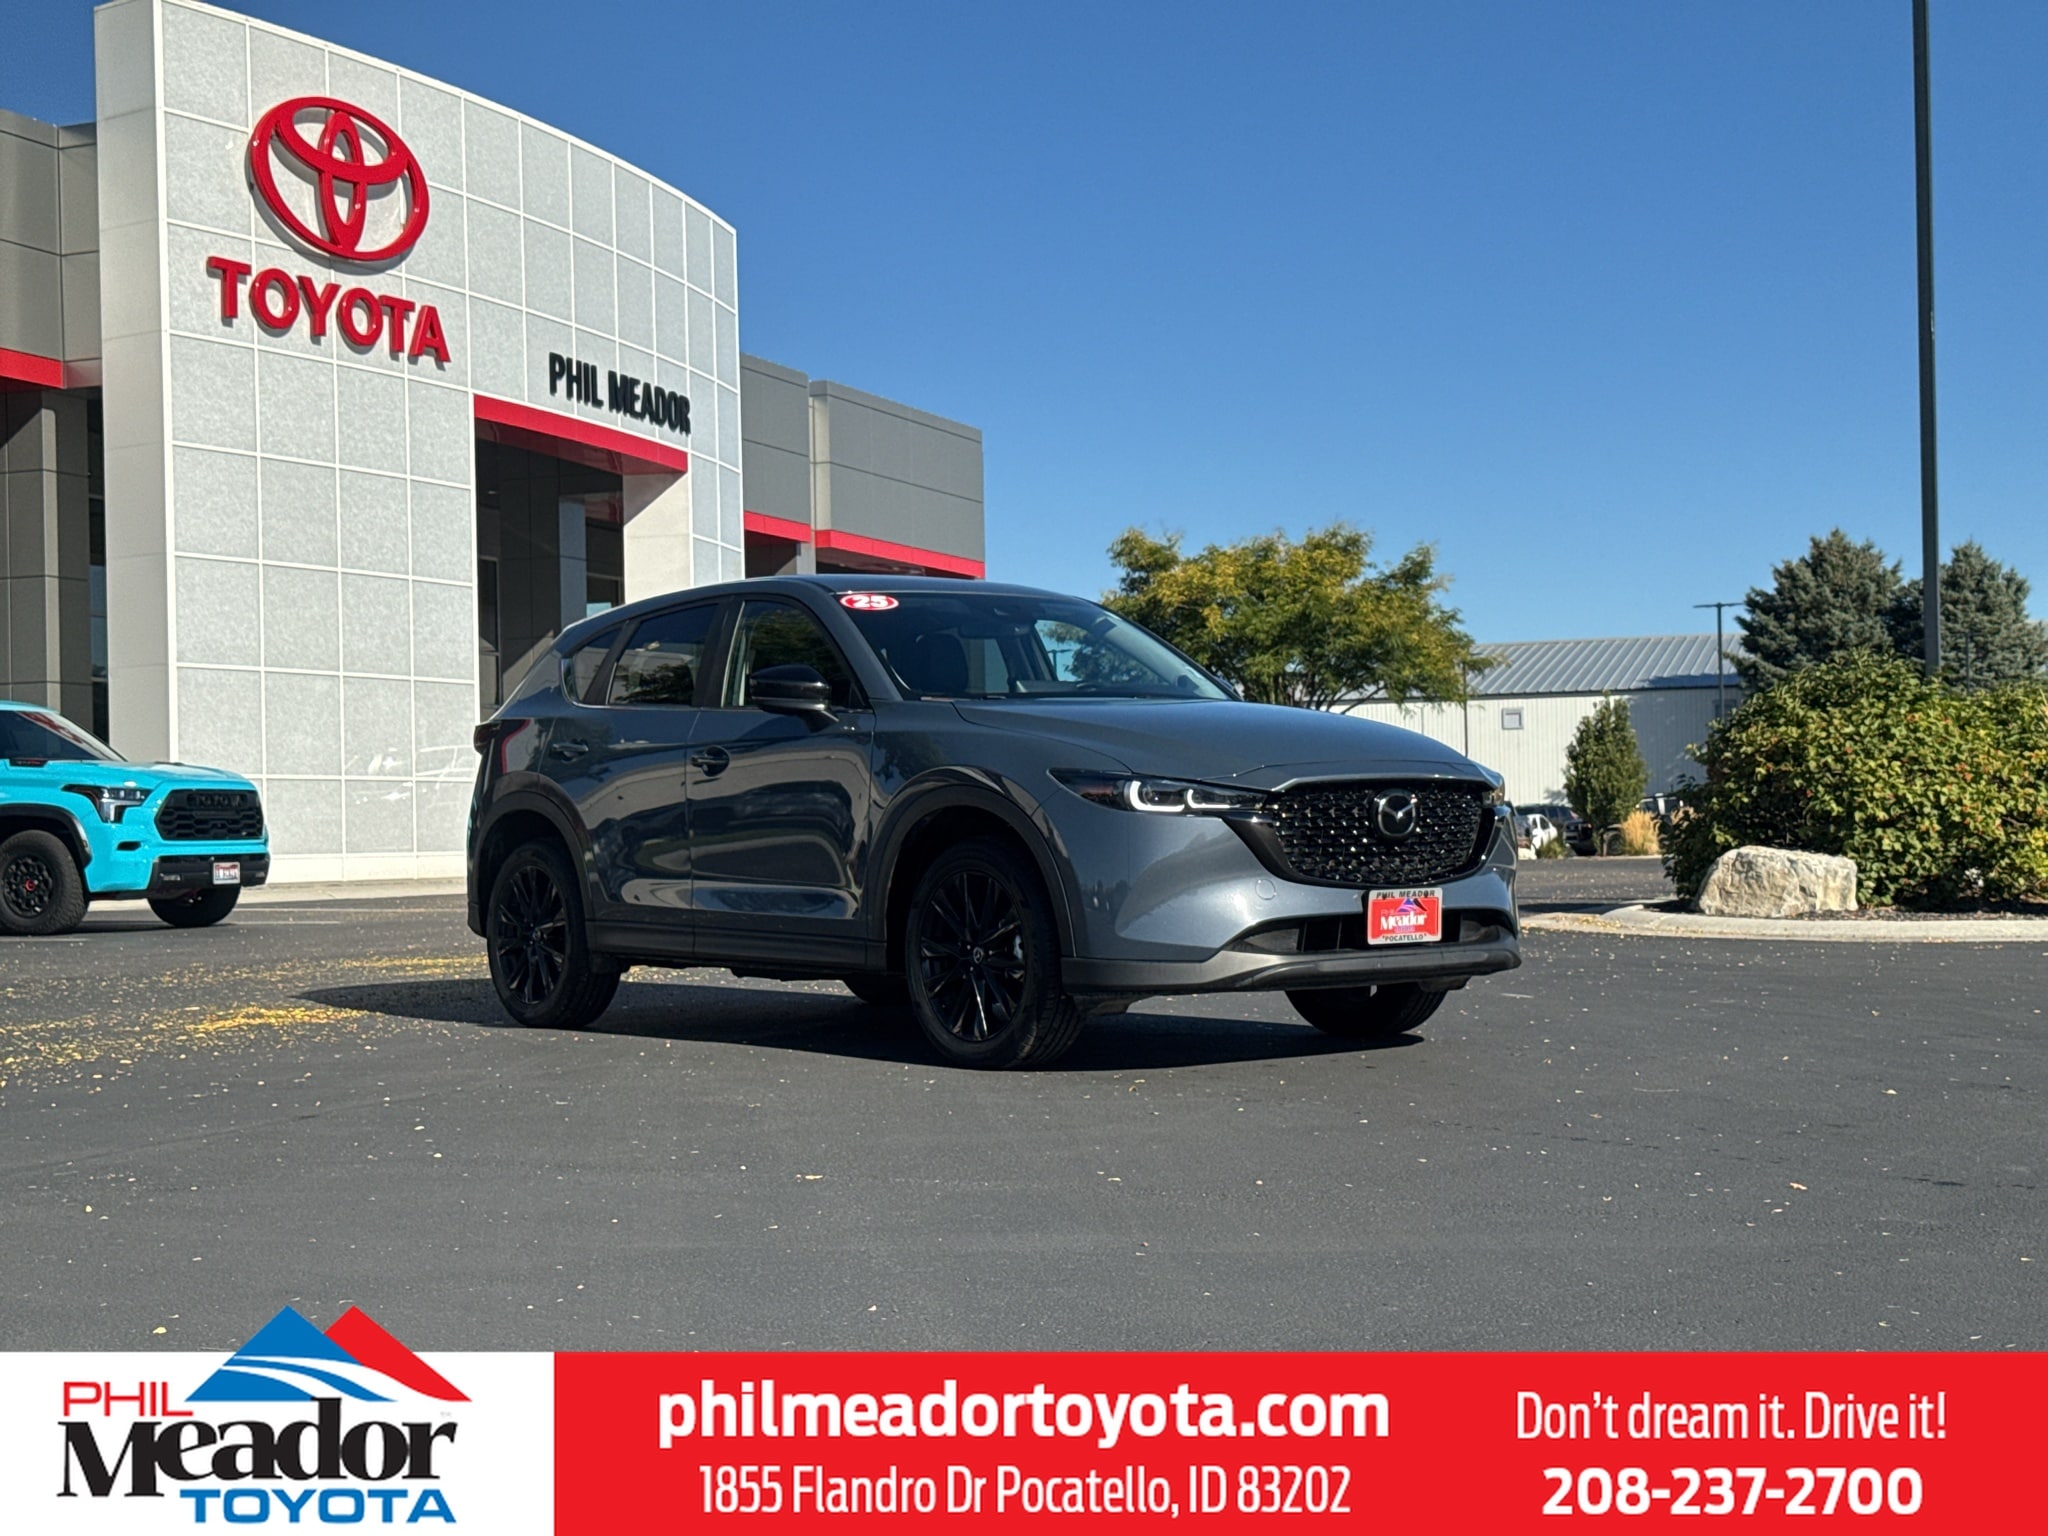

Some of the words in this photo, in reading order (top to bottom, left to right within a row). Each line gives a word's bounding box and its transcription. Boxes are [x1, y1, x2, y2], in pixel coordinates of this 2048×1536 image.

[207, 255, 450, 363] TOYOTA
[548, 352, 604, 411] PHIL
[607, 370, 692, 435] MEADOR
[852, 595, 890, 608] 25
[1376, 891, 1396, 899] PHIL
[1398, 889, 1436, 898] MEADOR
[1380, 911, 1428, 931] Meador
